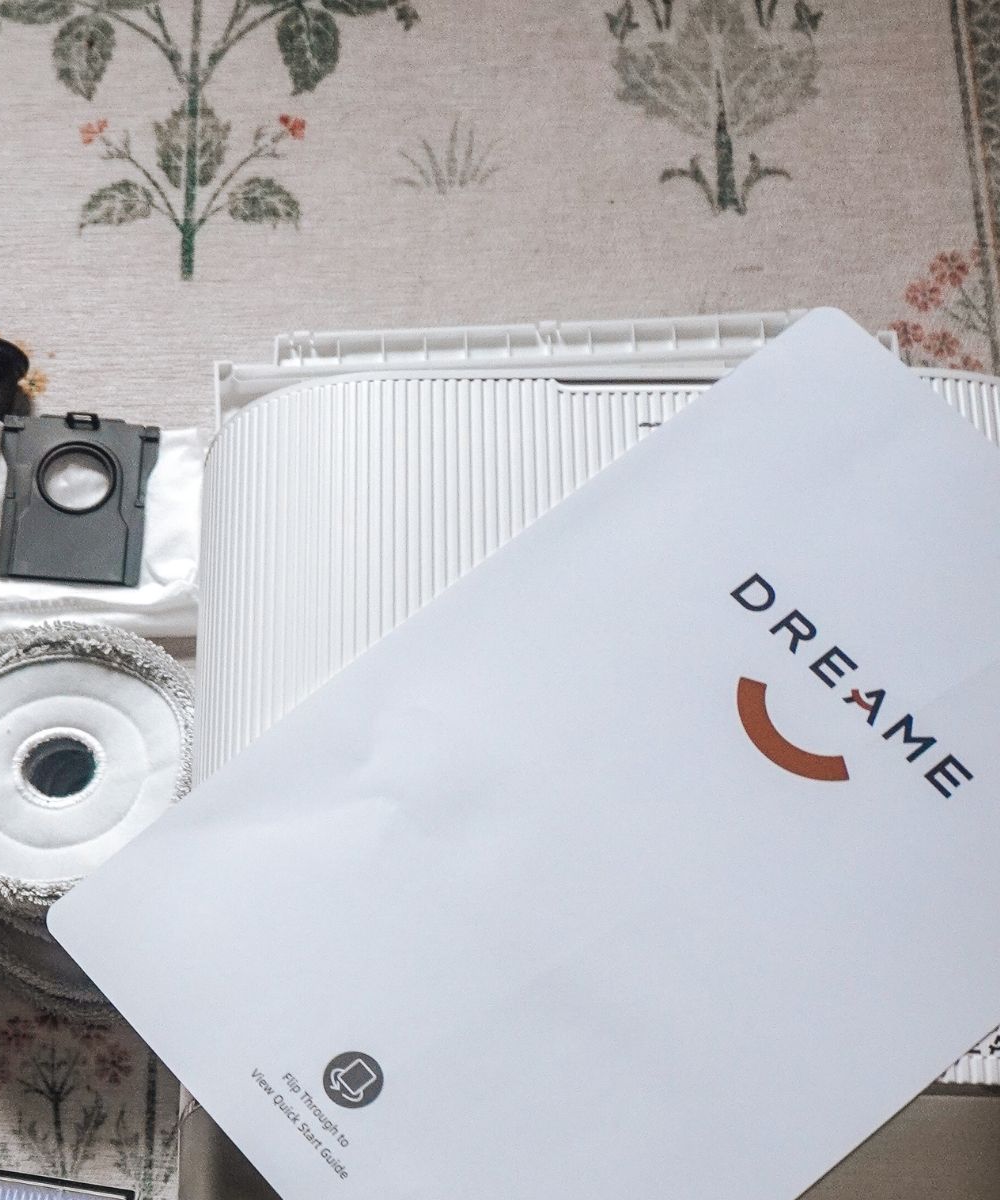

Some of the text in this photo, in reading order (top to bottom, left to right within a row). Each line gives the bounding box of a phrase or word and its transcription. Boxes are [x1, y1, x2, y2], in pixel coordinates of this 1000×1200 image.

[730, 573, 974, 799] DREAME
[251, 1068, 348, 1180] View Quick Start Guide
[282, 1072, 350, 1148] Flip Through to
